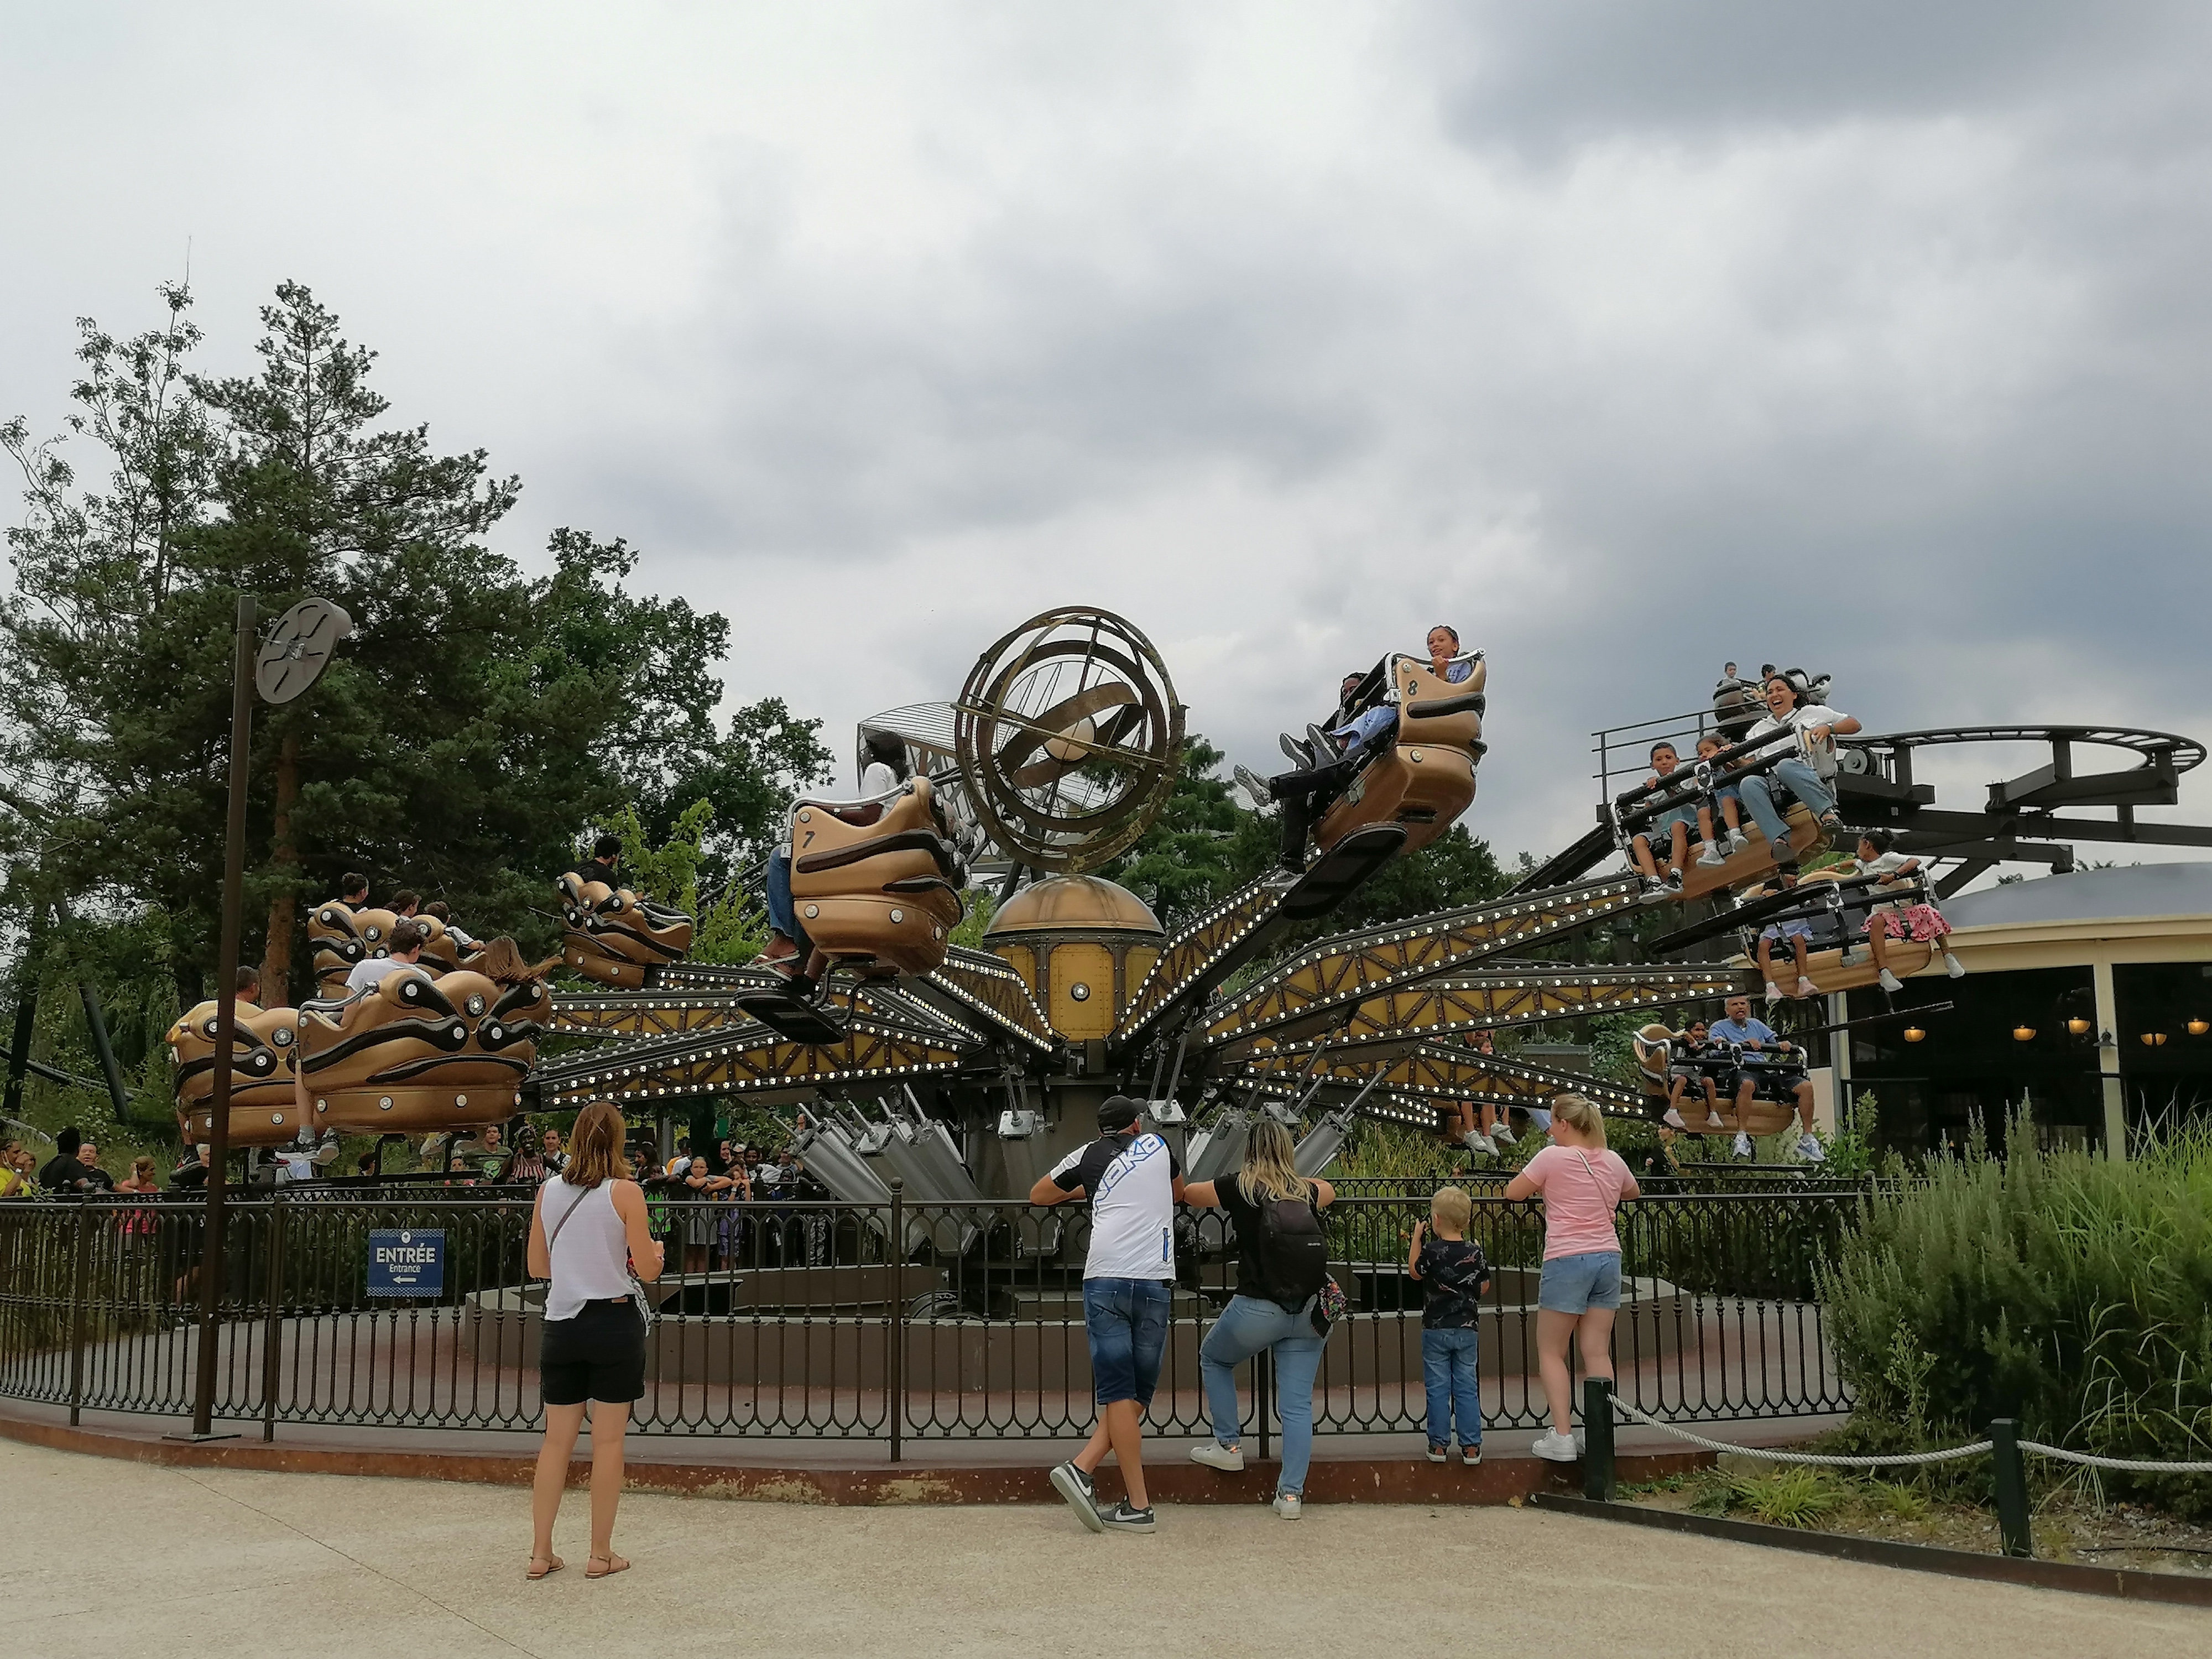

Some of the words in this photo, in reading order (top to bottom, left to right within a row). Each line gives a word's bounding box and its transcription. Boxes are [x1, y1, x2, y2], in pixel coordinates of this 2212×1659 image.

[1407, 680, 1418, 696] 8
[802, 831, 816, 849] 7
[376, 1243, 436, 1263] ENTRÉE
[389, 1264, 421, 1273] Entrance
